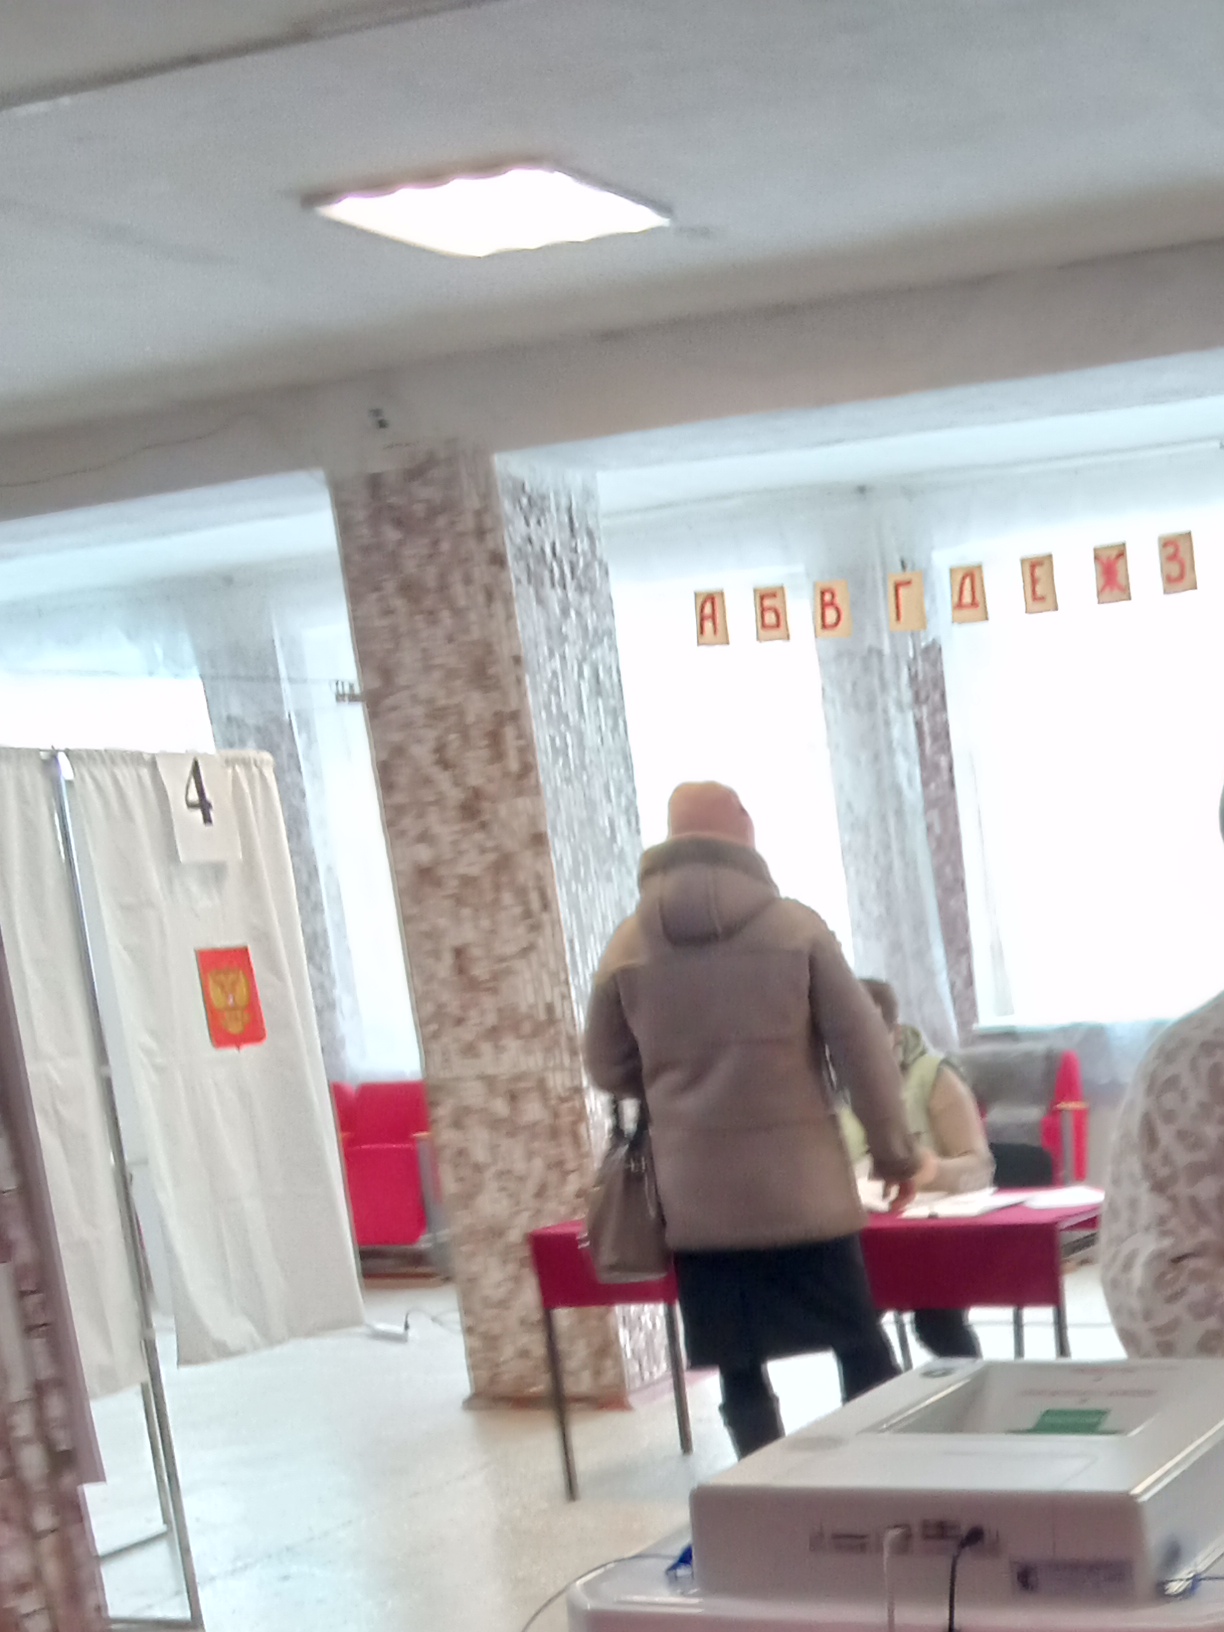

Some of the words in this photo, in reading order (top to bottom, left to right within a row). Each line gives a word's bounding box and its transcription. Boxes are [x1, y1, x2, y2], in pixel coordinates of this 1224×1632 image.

[700, 595, 719, 637] А
[760, 592, 783, 632] Б
[821, 588, 843, 631] В
[894, 580, 913, 623] Г
[953, 571, 981, 611] Д
[1029, 560, 1047, 603] Е
[1163, 540, 1187, 585] З
[185, 757, 213, 826] 4
